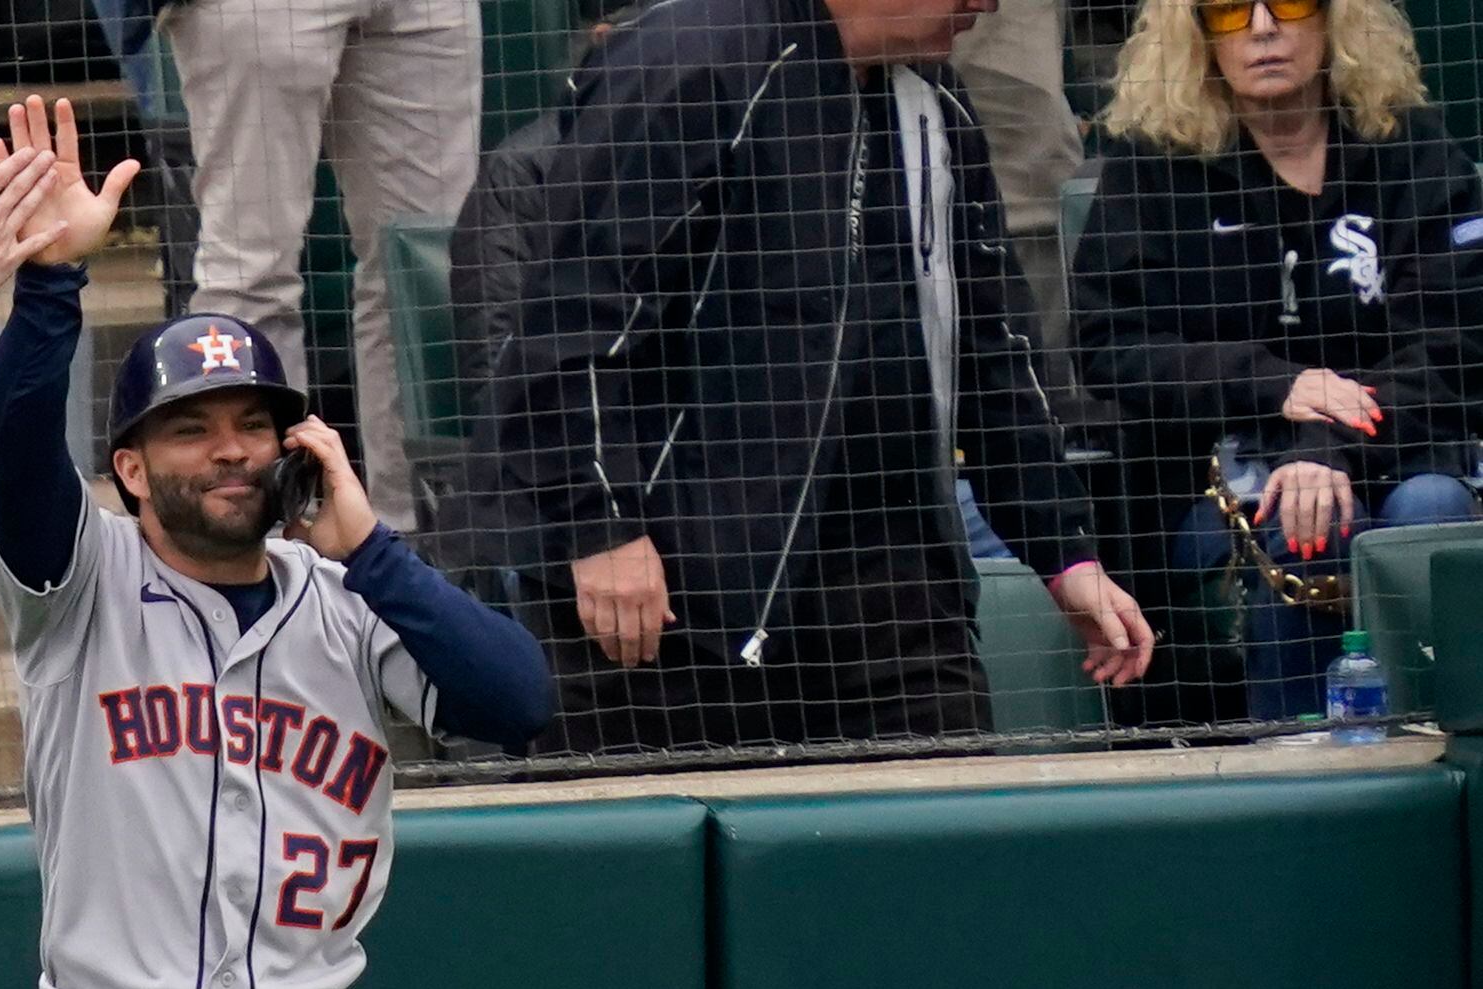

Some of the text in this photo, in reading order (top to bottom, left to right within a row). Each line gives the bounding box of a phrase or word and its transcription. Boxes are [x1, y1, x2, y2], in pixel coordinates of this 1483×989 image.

[196, 334, 240, 369] H
[98, 682, 389, 816] HOUSTON
[275, 831, 380, 932] 27
